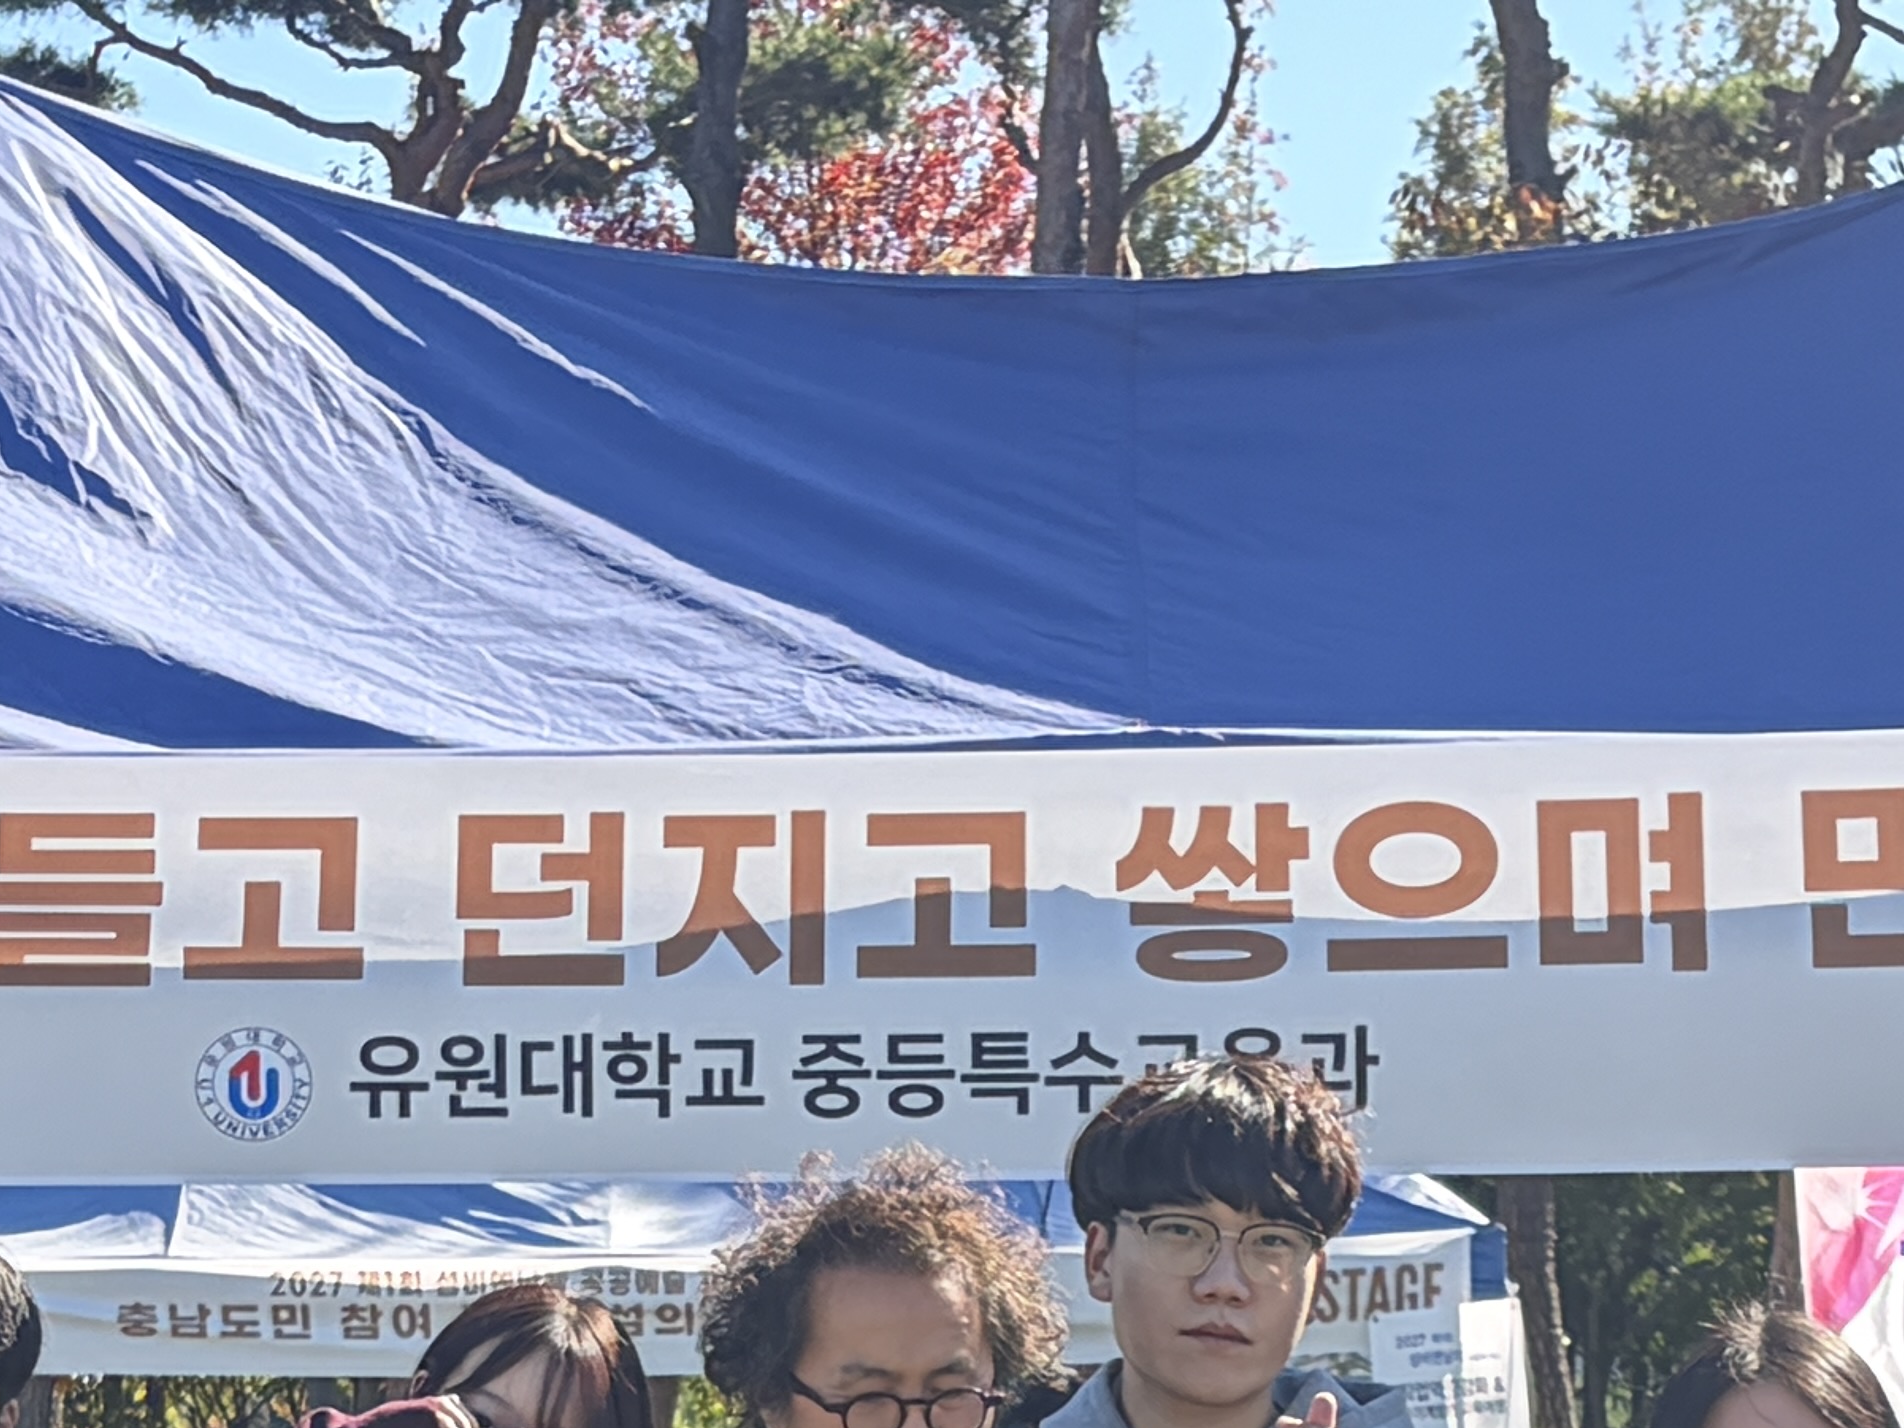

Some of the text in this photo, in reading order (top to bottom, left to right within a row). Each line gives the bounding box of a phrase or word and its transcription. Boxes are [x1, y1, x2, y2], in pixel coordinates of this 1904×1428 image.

[454, 806, 1037, 987] 던지고
[1115, 790, 1708, 981] 쌓으며
[348, 1033, 766, 1119] 유원대학교
[270, 1271, 343, 1297] 2027
[116, 1302, 313, 1340] 충남도민
[341, 1303, 433, 1340] 참여
